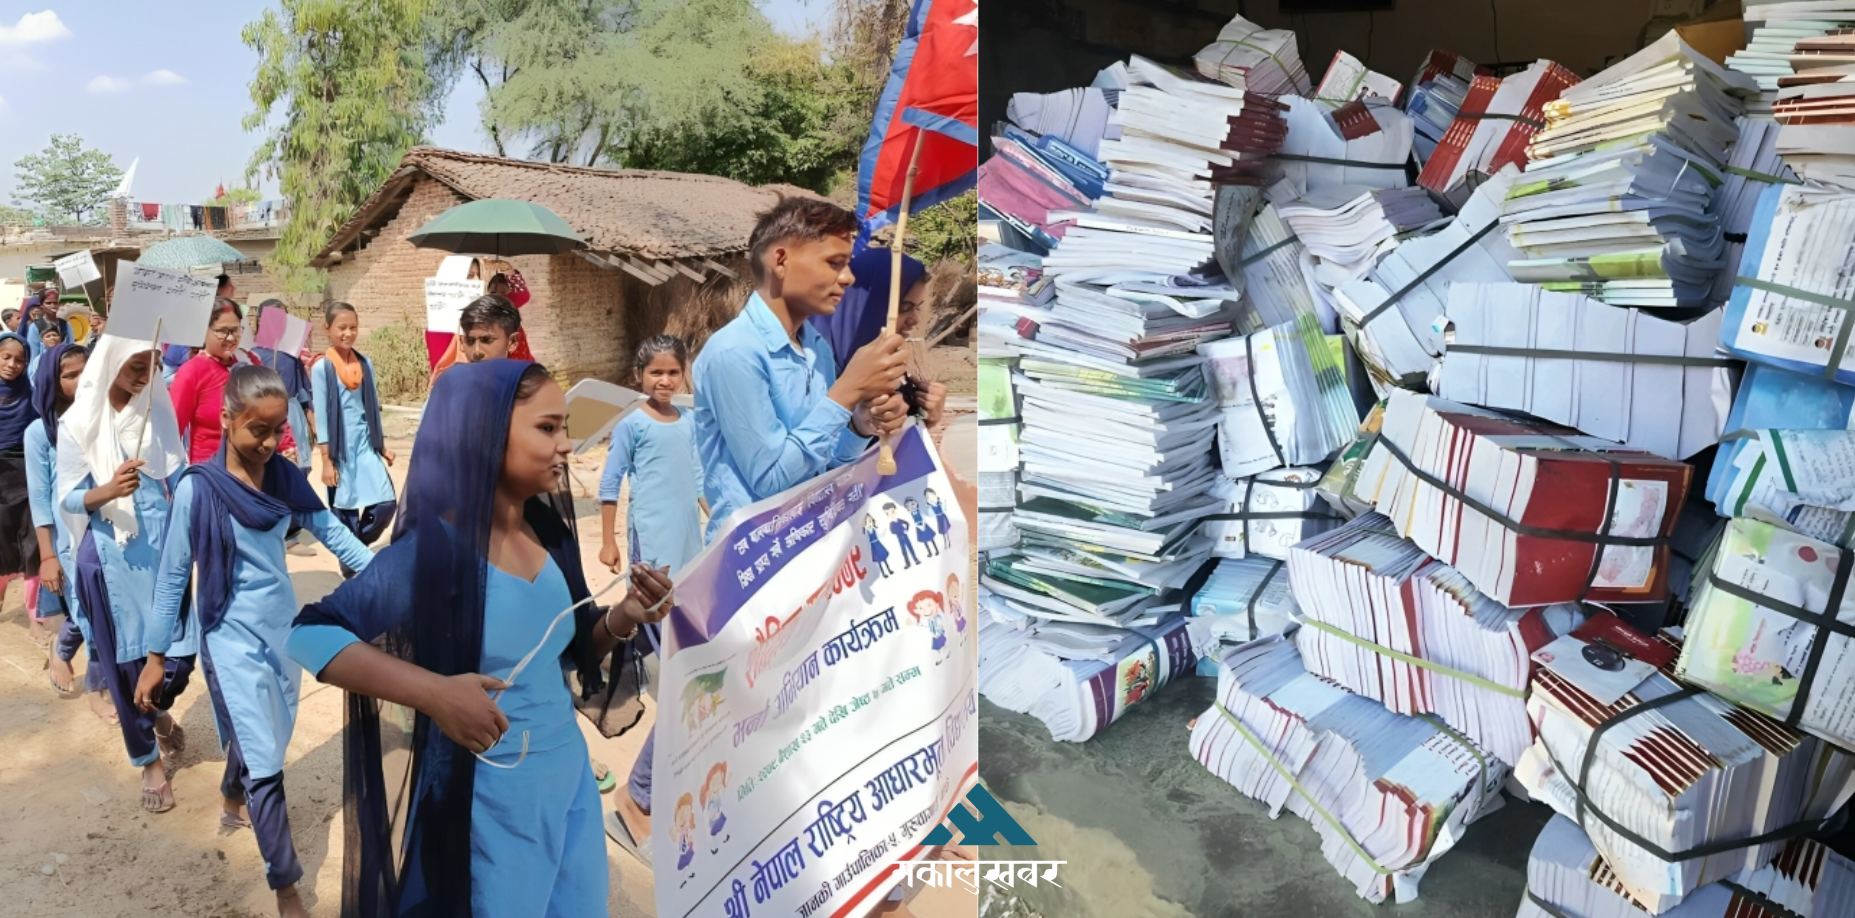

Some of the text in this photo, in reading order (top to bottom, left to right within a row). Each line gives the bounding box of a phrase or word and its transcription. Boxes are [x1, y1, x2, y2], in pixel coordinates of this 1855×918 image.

[772, 650, 821, 720] अभियान
[821, 606, 900, 667] कार्यक्रम
[723, 879, 751, 918] श्री
[750, 836, 806, 904] नेपाल
[803, 790, 867, 845] राष्ट्रिय
